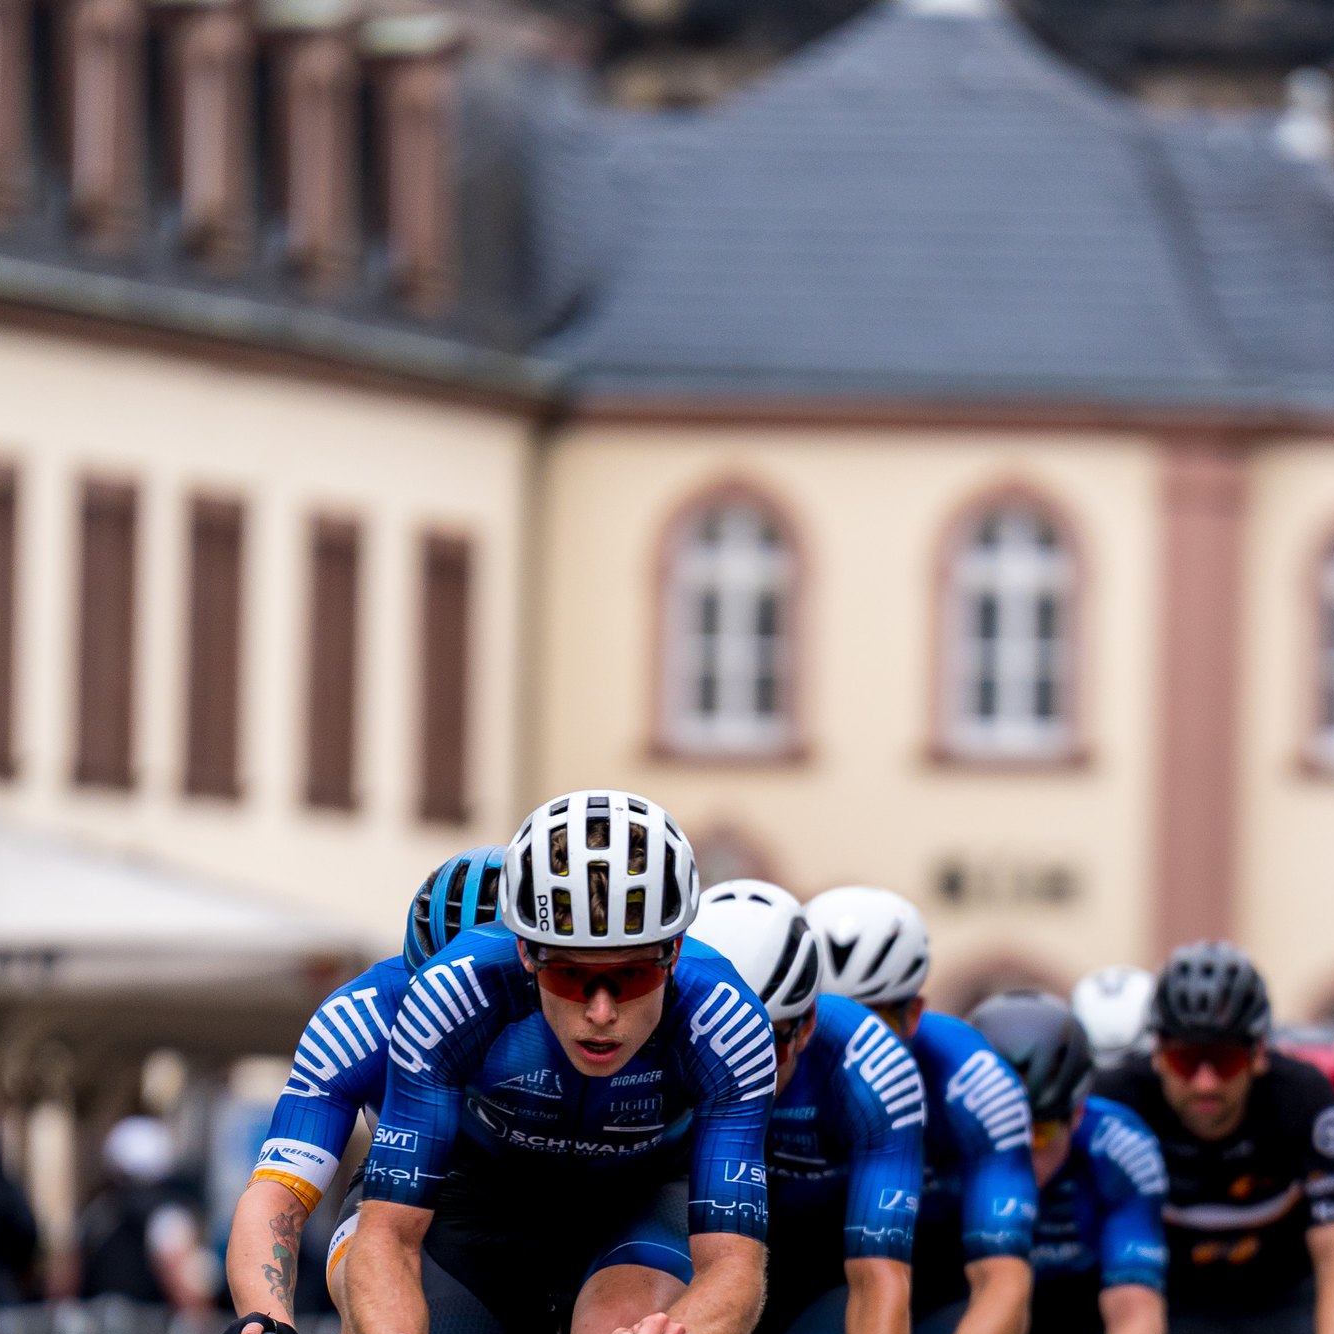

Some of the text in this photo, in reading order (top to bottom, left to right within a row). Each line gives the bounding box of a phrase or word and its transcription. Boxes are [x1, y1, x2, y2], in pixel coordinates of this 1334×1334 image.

[610, 1070, 663, 1087] BIORACER
[610, 1098, 658, 1113] LIGHT
[374, 1127, 413, 1147] SWT
[281, 1147, 325, 1165] REISEN
